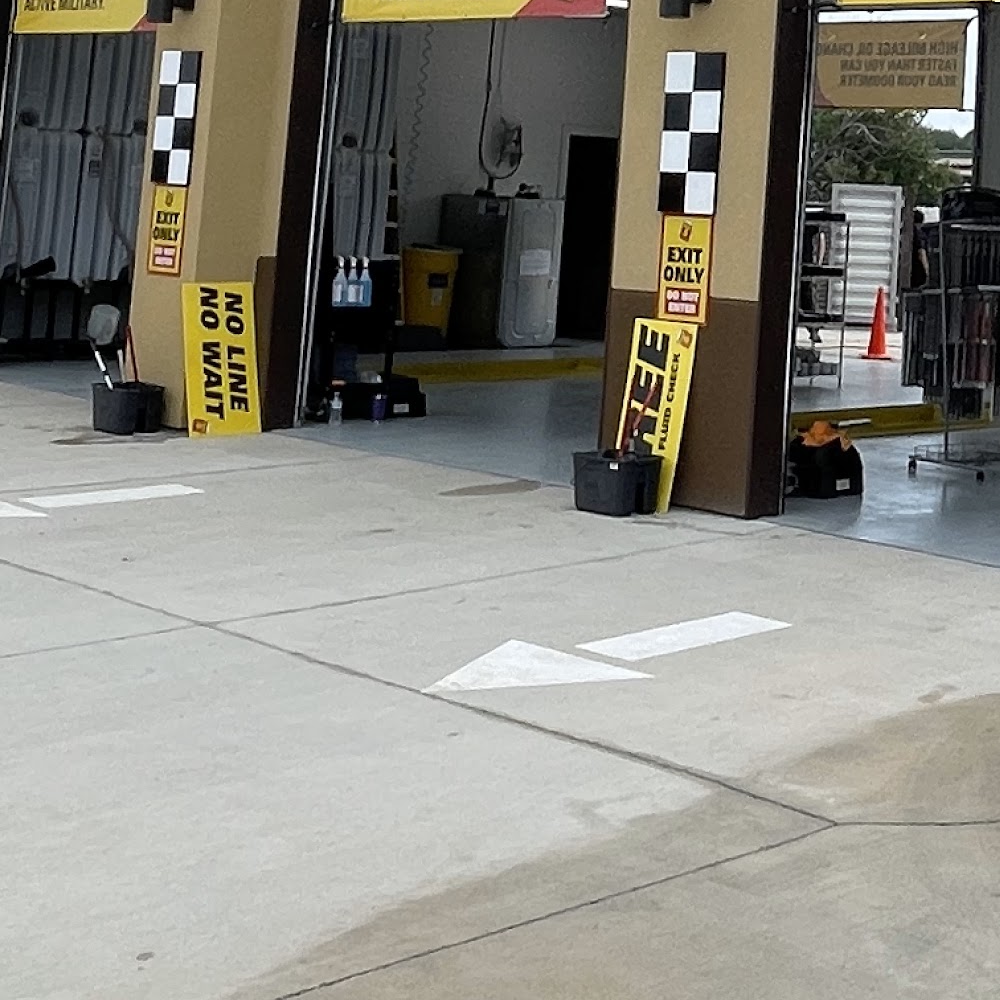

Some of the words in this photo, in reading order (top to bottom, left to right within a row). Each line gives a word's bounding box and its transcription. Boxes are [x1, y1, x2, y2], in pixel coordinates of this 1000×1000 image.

[153, 226, 180, 241] ONLY
[156, 210, 180, 225] EXIT
[664, 265, 705, 284] ONLY
[667, 246, 703, 265] EXIT
[199, 286, 220, 330] NO
[224, 292, 246, 335] NO
[201, 341, 225, 420] WAIT
[227, 345, 250, 412] LINE
[658, 408, 672, 451] FLUID
[665, 353, 681, 403] CHECK
